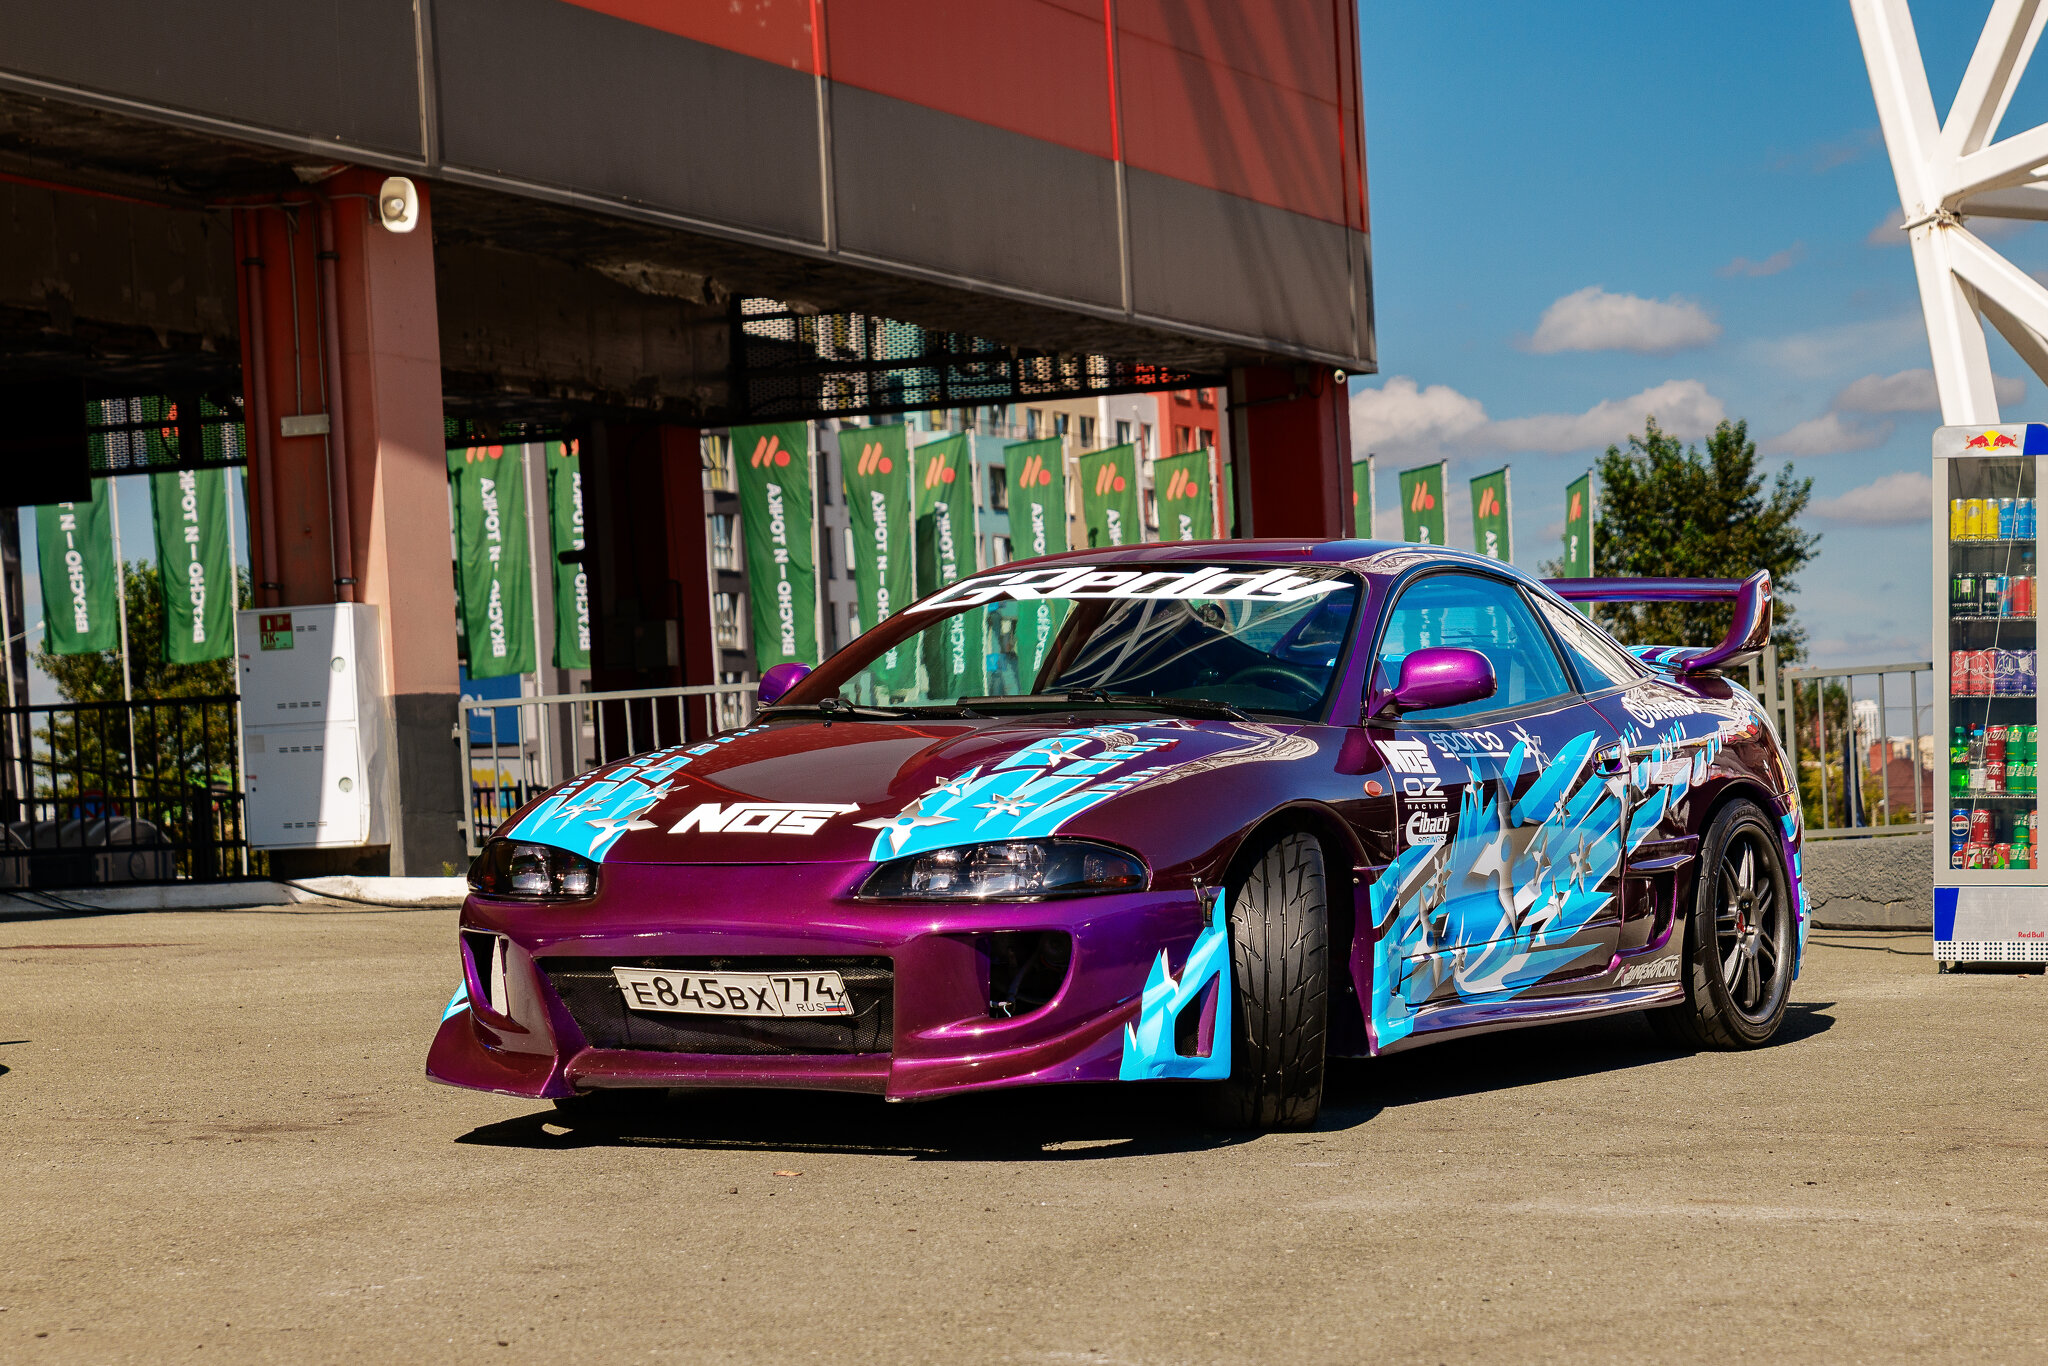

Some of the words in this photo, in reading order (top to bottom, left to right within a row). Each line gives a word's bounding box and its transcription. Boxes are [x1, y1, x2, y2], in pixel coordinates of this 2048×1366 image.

[1375, 735, 1437, 774] NOS
[1428, 731, 1504, 761] sparco
[667, 802, 861, 836] NOS
[1405, 811, 1450, 841] Eibach
[773, 977, 838, 1002] 774
[796, 1003, 825, 1012] RUS
